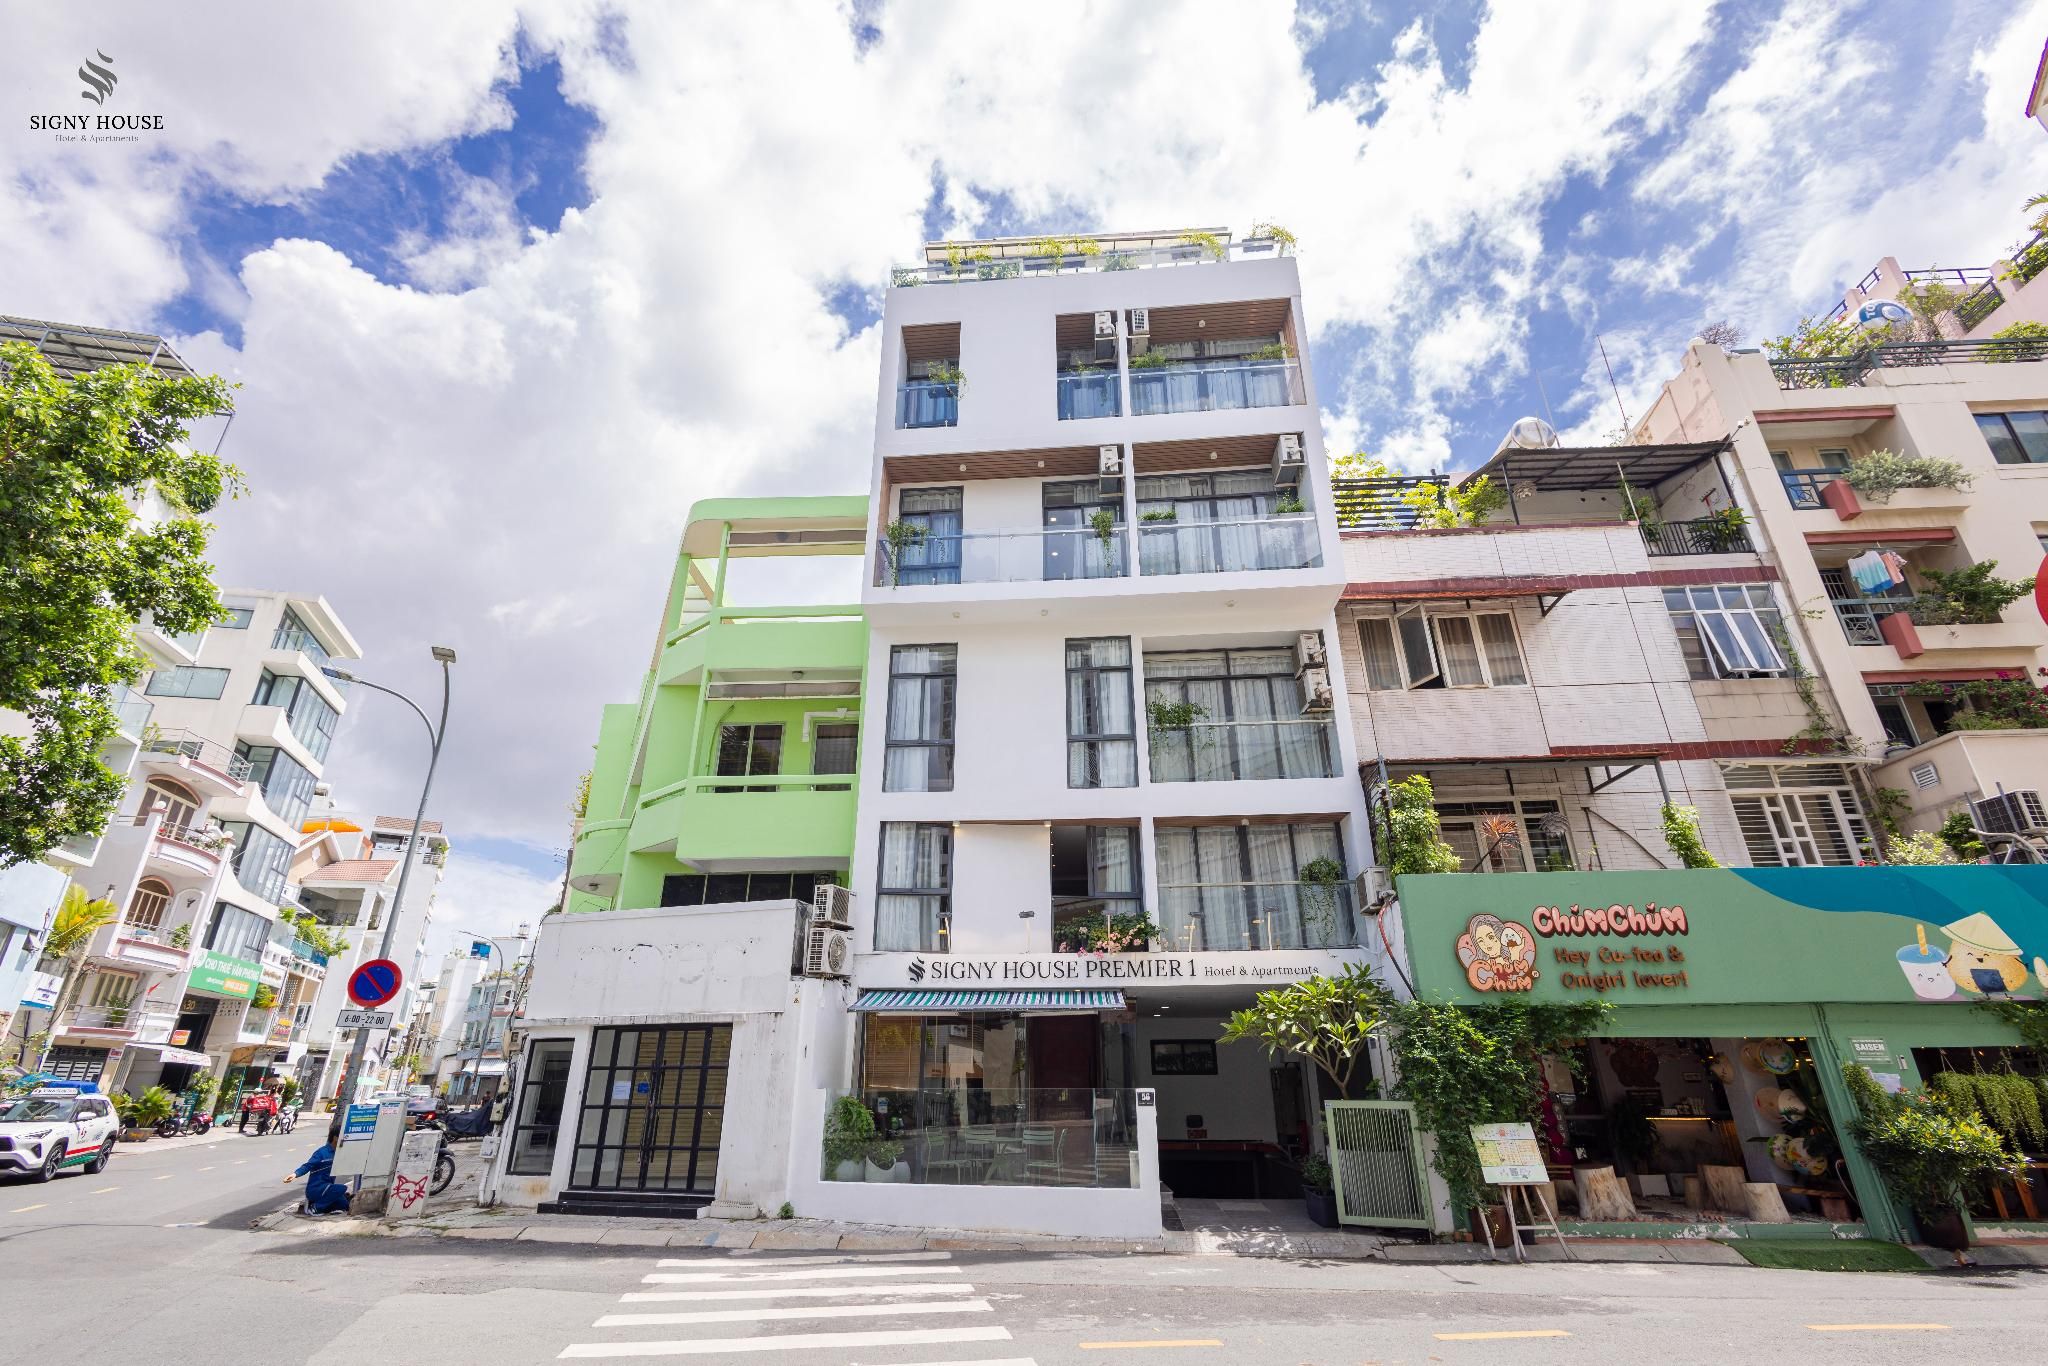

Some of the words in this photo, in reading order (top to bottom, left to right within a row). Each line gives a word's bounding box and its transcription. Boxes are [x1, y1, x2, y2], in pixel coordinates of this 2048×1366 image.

[1554, 947, 1591, 968] Hey
[1667, 945, 1685, 962] &
[931, 961, 997, 979] SIGNY
[1004, 960, 1079, 979] HOUSE
[1086, 959, 1184, 979] PREMIER
[1188, 959, 1197, 977] 1
[1204, 965, 1235, 977] Hotel
[1239, 966, 1248, 976] &
[1251, 965, 1319, 979] Apartments
[1562, 970, 1626, 993] Onigiri
[1854, 1043, 1885, 1051] SAISEN
